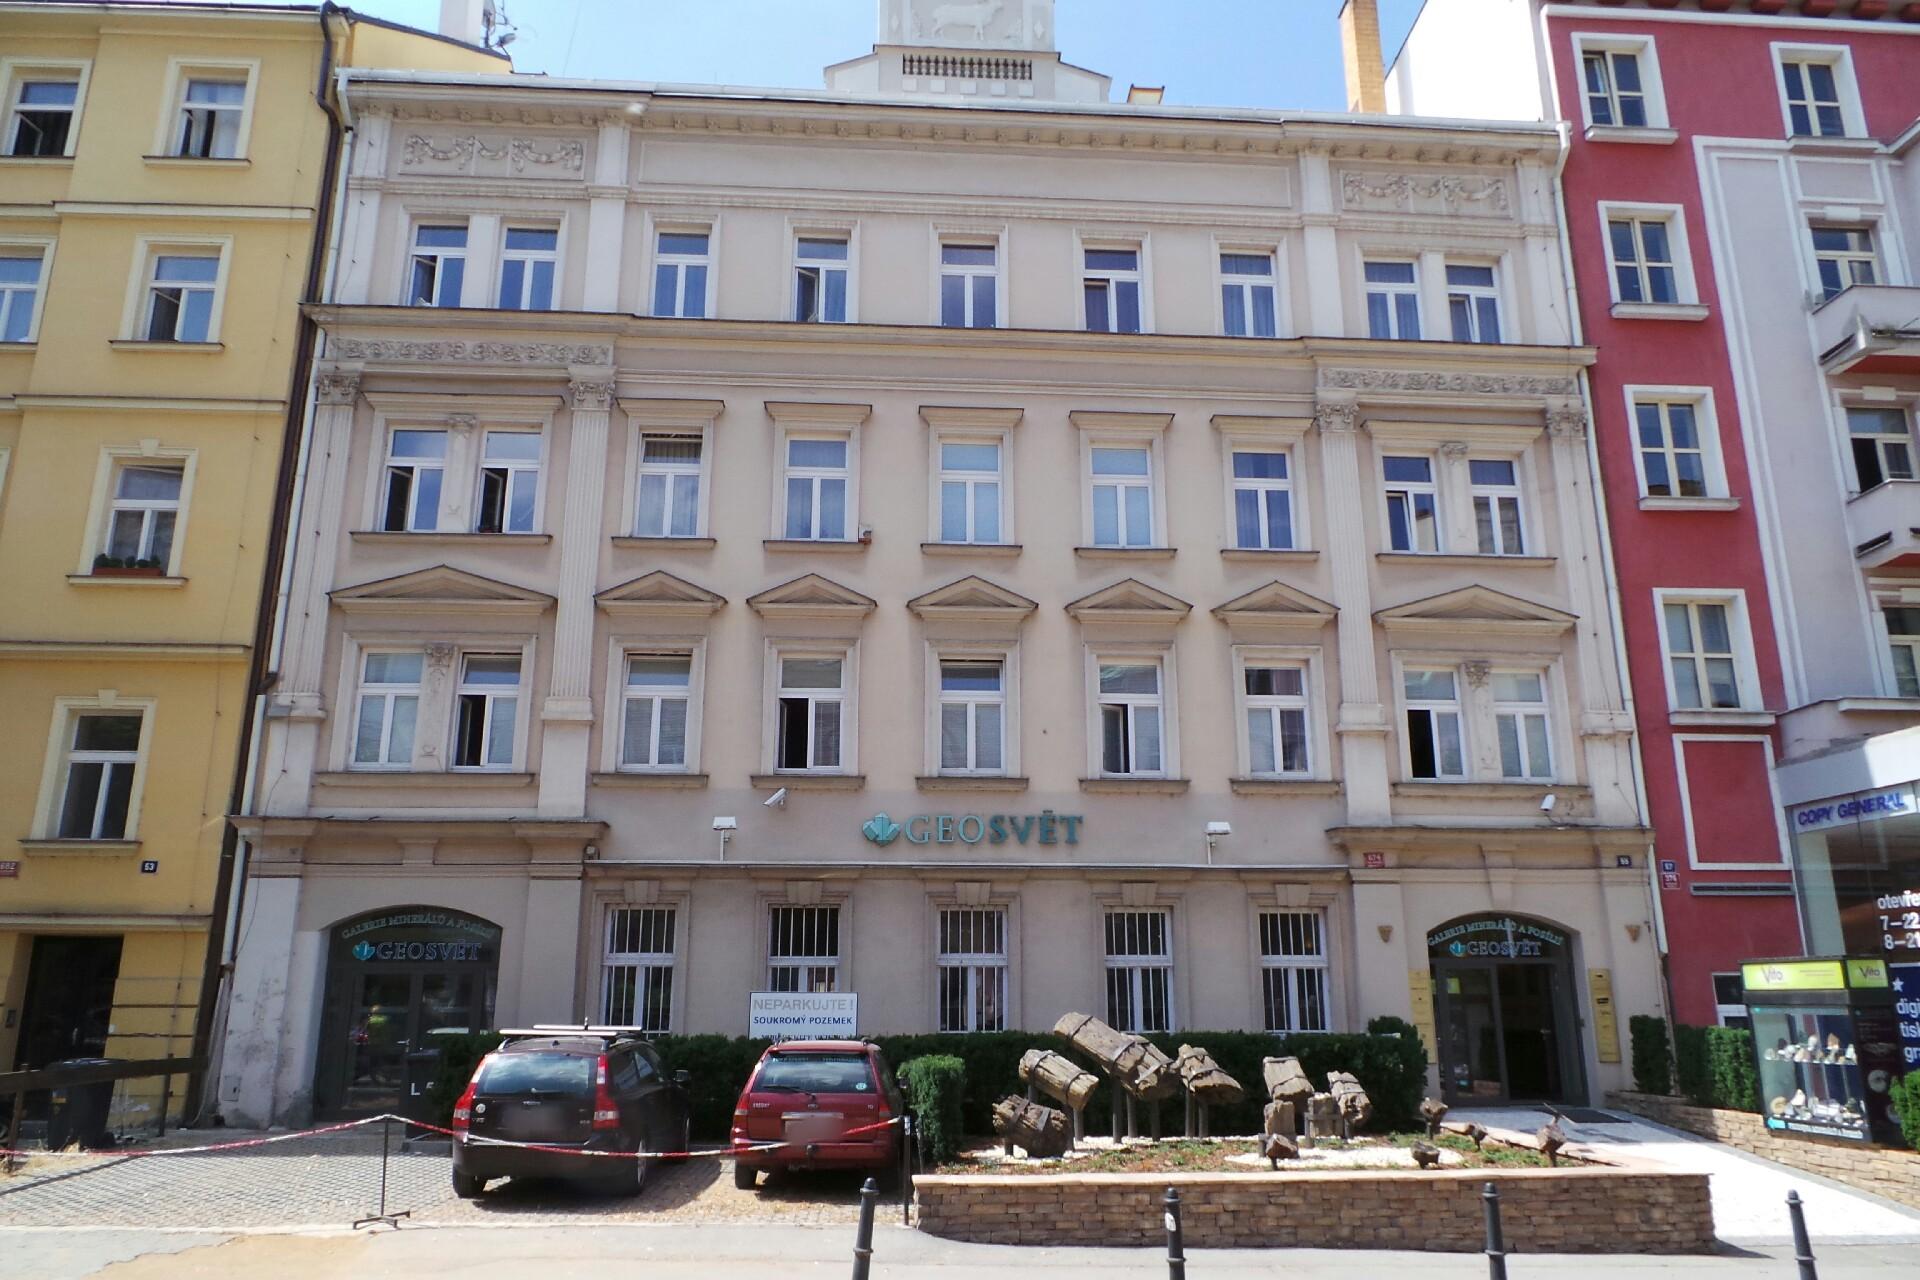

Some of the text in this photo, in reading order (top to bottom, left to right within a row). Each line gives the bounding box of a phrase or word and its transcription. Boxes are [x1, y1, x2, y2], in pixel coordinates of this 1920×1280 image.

[1797, 792, 1904, 825] COPY GENERAL
[905, 809, 1084, 845] GEOSVĚT
[342, 916, 387, 939] GALERIE
[447, 918, 455, 928] A
[1428, 925, 1466, 946] GALERIE
[1518, 925, 1526, 934] A
[376, 939, 482, 961] GEOSVĚT
[1467, 939, 1542, 956] GEOSVĚT
[1859, 965, 1881, 979] Vito
[753, 999, 848, 1011] NEPARKUJTE
[753, 1014, 853, 1025] SOUKROMÝ POZEMEK
